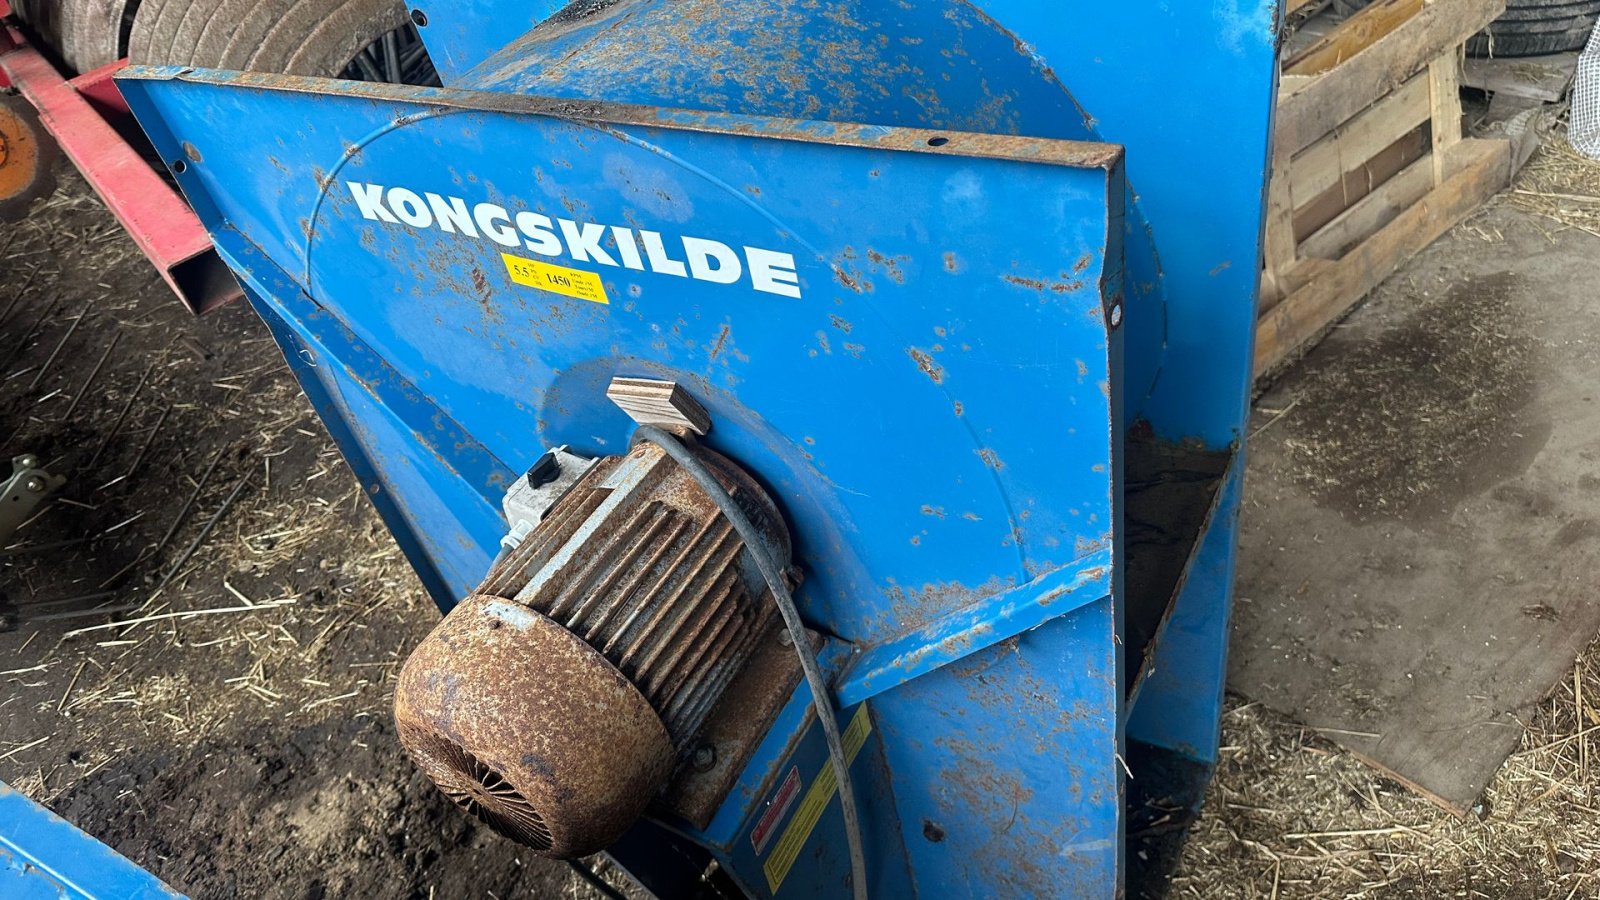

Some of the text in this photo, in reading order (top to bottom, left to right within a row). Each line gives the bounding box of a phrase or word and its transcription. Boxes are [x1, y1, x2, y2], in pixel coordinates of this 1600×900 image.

[346, 181, 801, 298] KONGSKILDE
[513, 264, 530, 278] 5.5
[546, 273, 571, 287] 1450
